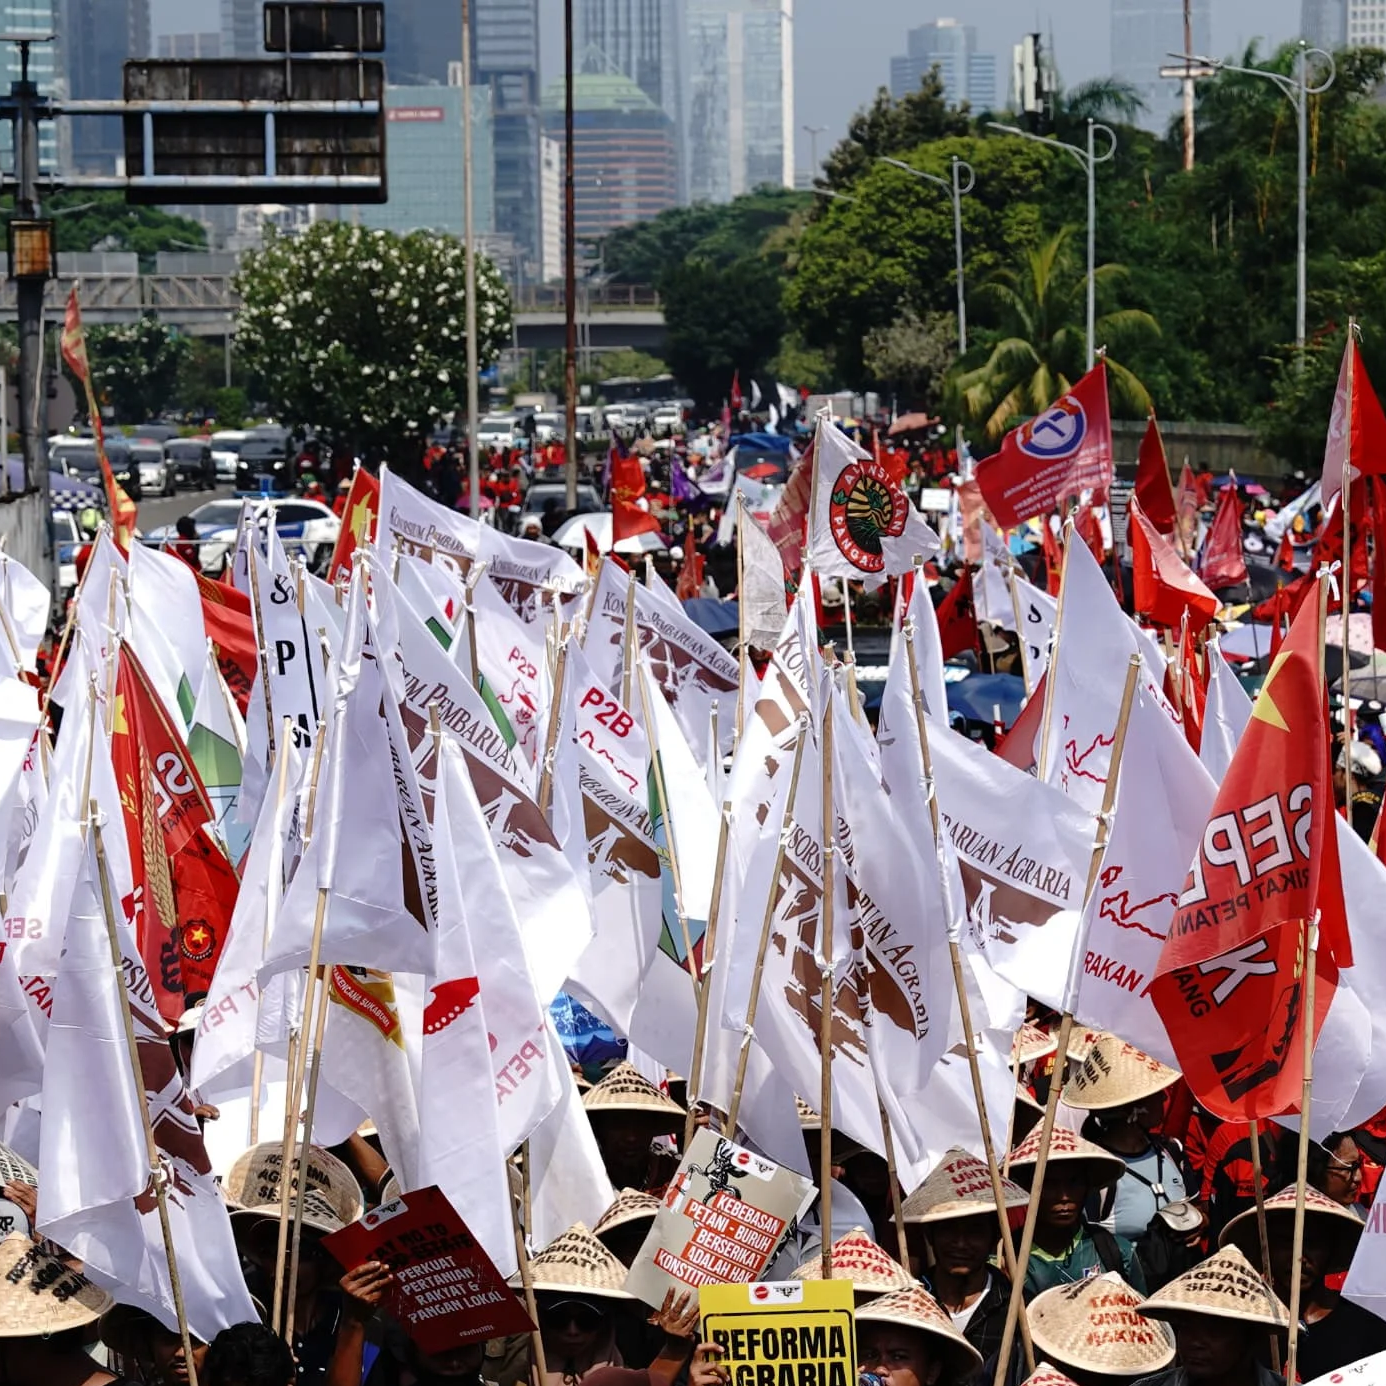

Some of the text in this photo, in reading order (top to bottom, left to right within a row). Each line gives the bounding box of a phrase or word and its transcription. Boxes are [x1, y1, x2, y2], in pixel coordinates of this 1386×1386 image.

[580, 687, 634, 738] P2B
[717, 1194, 781, 1235] KEBEBASAN
[397, 1255, 457, 1283] PERKUAT
[402, 1267, 475, 1296] PERTANIAN
[464, 1291, 507, 1309] LOKAL
[712, 1326, 847, 1361] REFORMA
